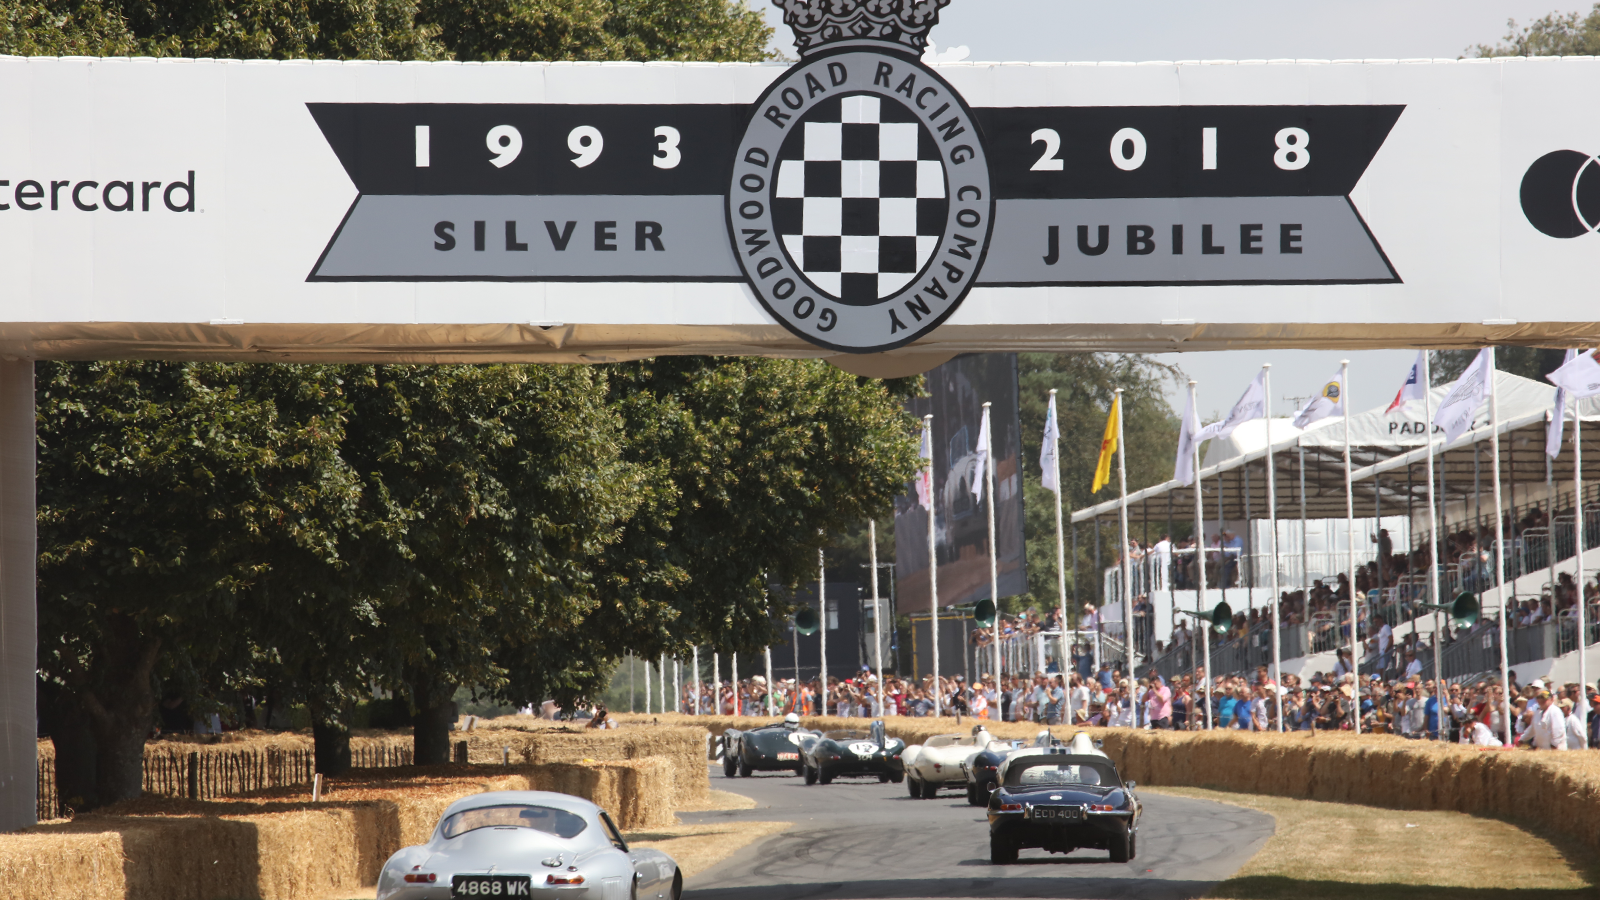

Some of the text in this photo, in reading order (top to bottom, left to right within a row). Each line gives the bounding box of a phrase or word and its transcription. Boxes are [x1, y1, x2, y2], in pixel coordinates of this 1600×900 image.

[416, 125, 681, 169] 1993
[1030, 127, 1310, 170] 2018
[739, 61, 982, 334] GOODWOOD ROAD RACING COMPANY
[434, 221, 665, 251] SILVER
[1043, 223, 1303, 265] JUBILEE
[1034, 809, 1078, 819] ECD 400
[457, 881, 529, 896] 4868 WK
